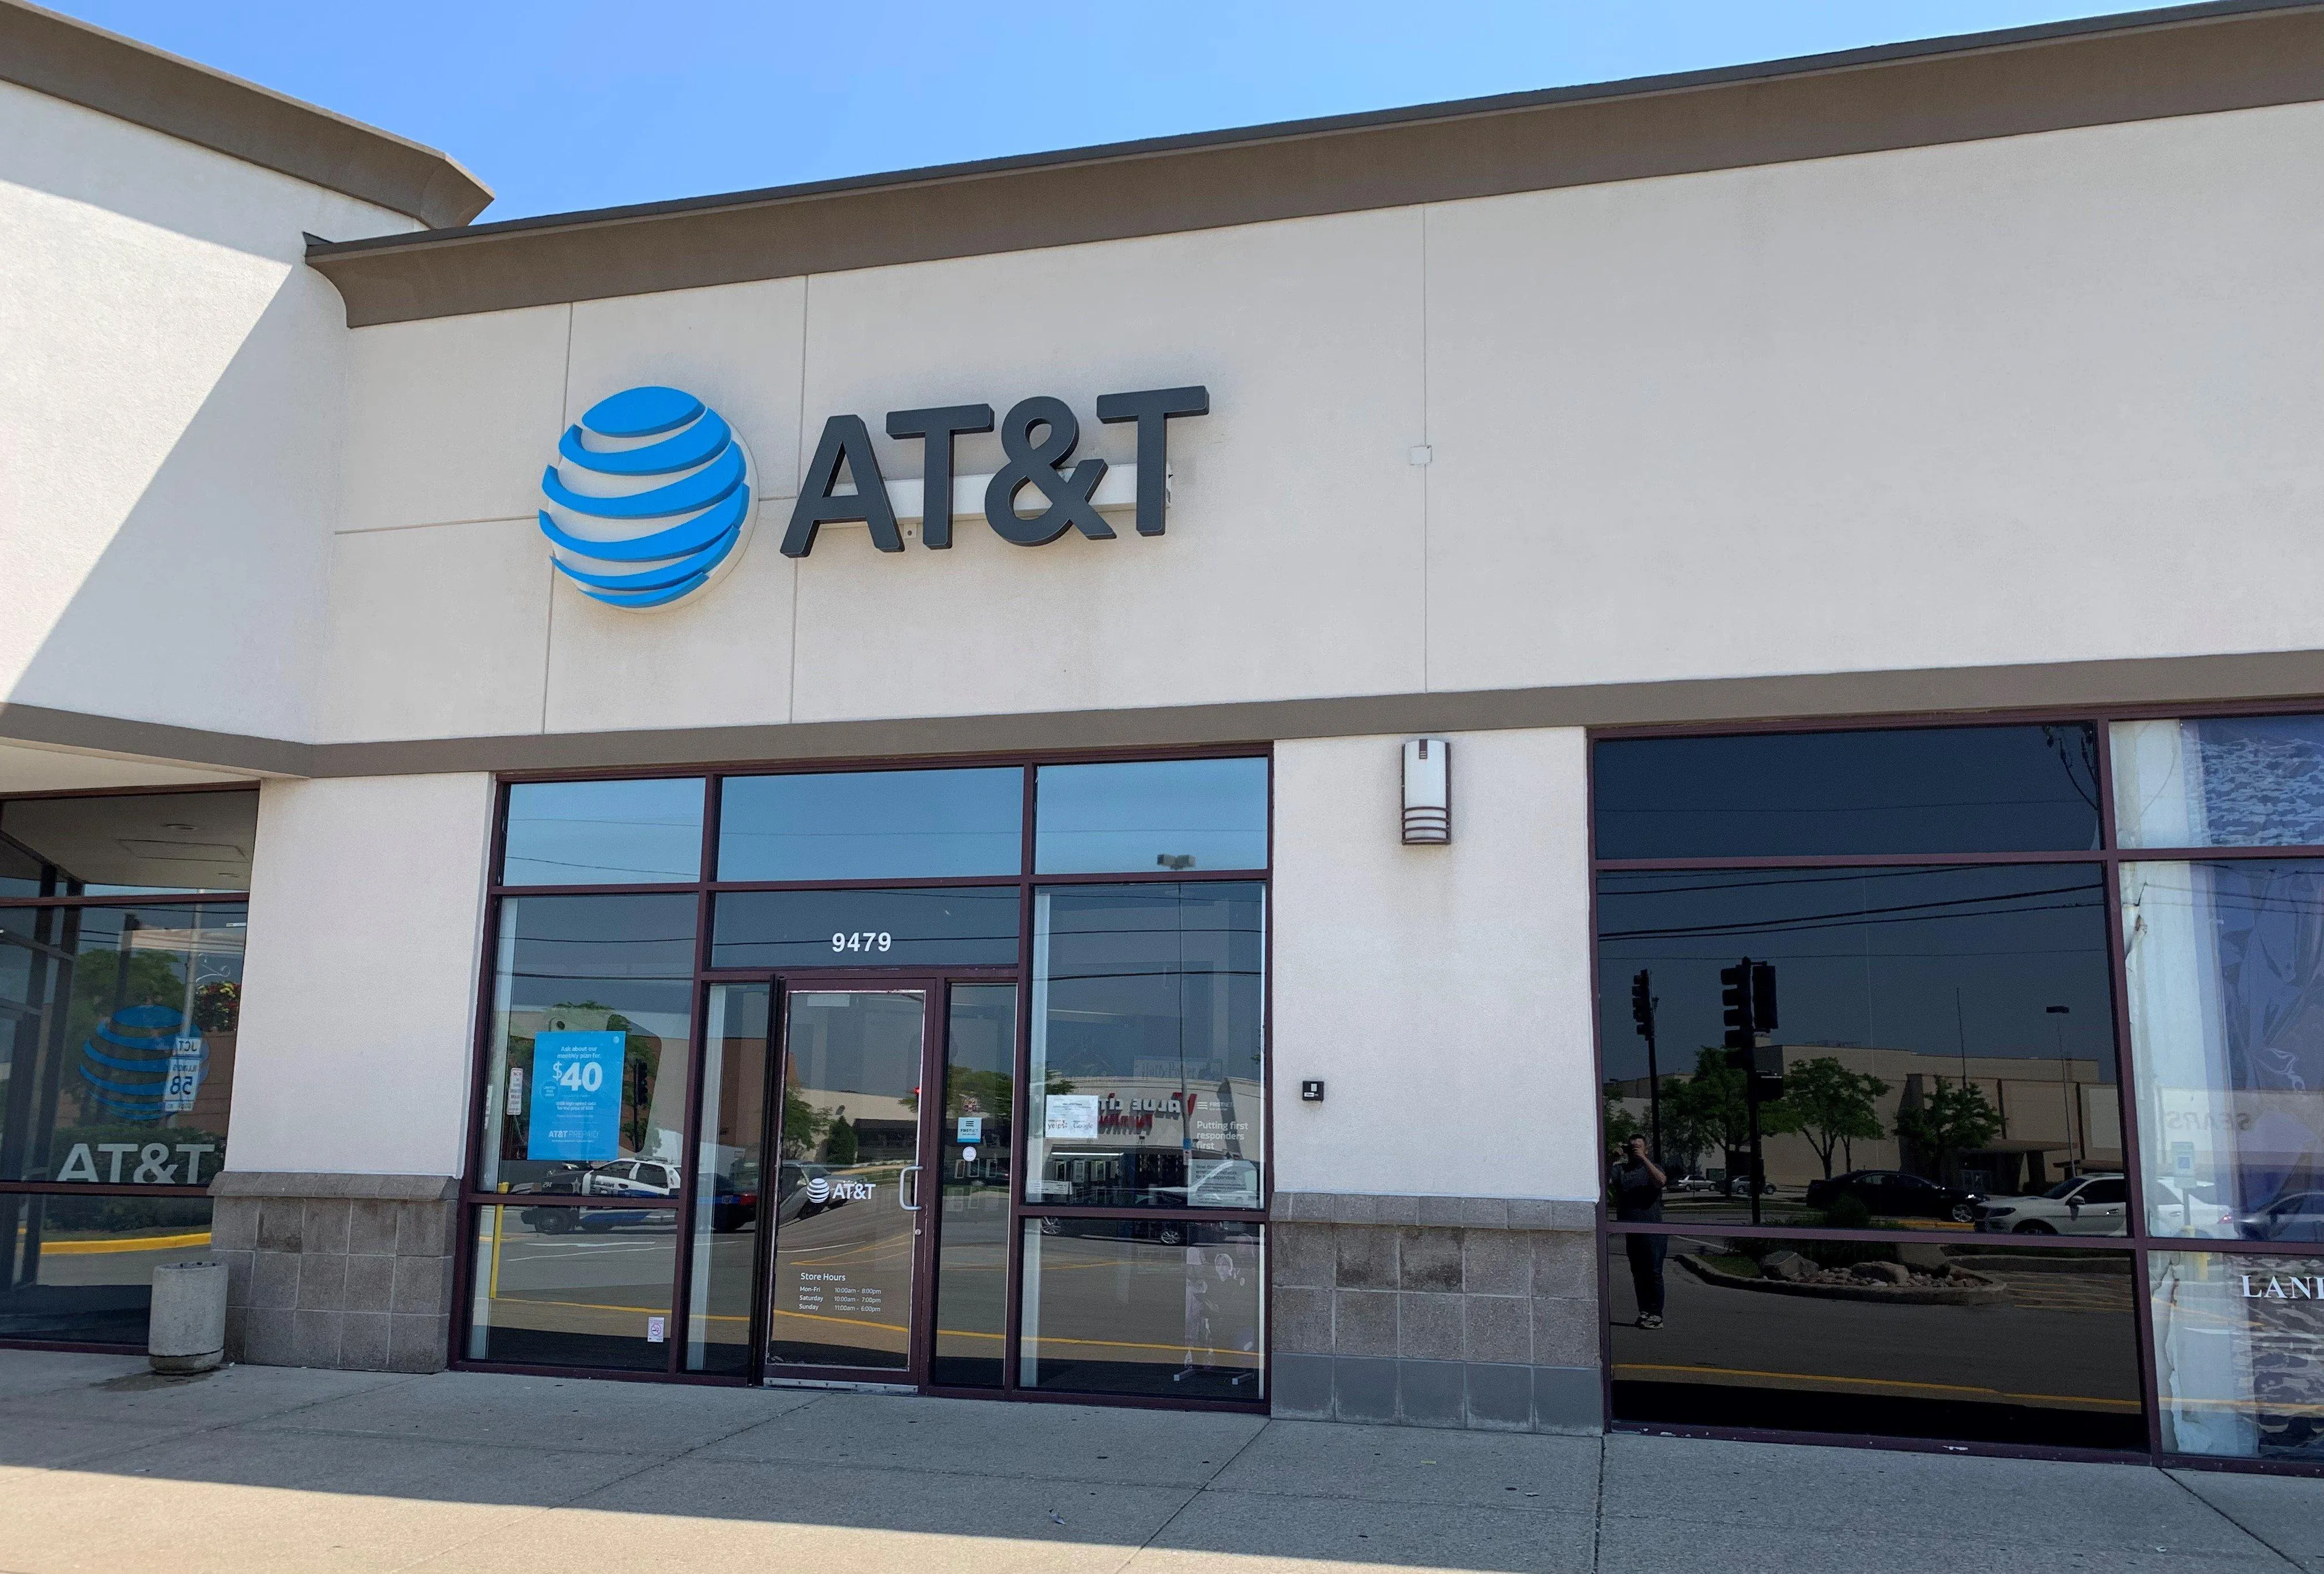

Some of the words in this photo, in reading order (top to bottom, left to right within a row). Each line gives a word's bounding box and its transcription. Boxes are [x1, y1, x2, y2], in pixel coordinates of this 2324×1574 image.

[780, 385, 1209, 558] AT&T
[832, 932, 891, 952] 9479
[552, 1061, 603, 1092] $40
[1197, 1120, 1228, 1131] Putting
[1230, 1120, 1249, 1130] first
[548, 1130, 568, 1138] AT&T
[1196, 1131, 1245, 1142] responders
[1195, 1141, 1215, 1150] first
[56, 1143, 215, 1184] AT&T
[832, 1183, 876, 1199] AT&T
[801, 1273, 821, 1281] Store
[823, 1273, 846, 1281] Hours
[799, 1303, 819, 1311] Sunday
